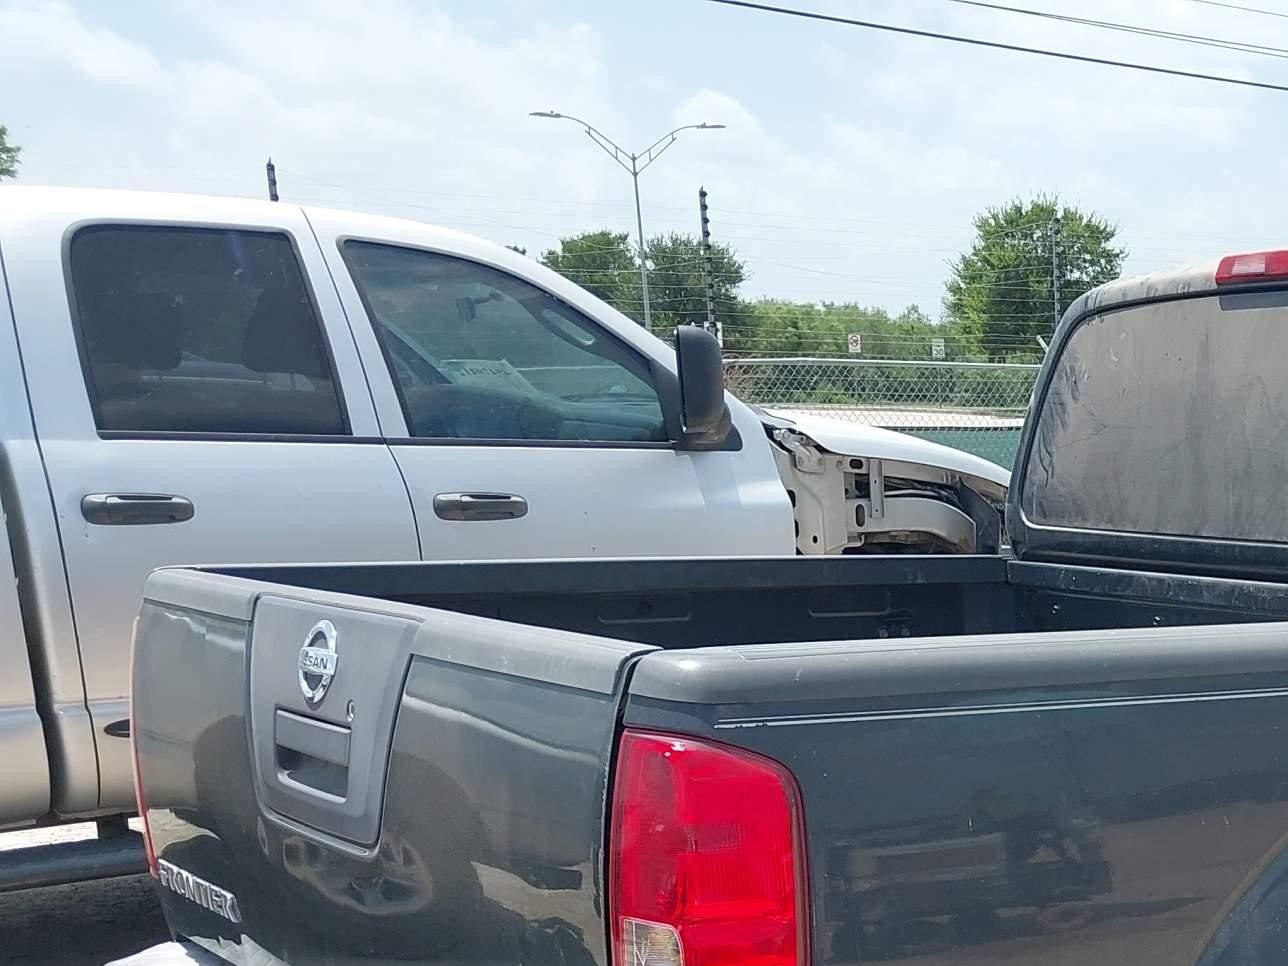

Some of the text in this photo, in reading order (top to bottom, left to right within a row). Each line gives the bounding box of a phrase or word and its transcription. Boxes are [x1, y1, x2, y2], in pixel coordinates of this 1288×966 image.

[933, 348, 944, 356] 30
[302, 650, 329, 670] SSAN
[158, 858, 242, 924] FRONTIER
